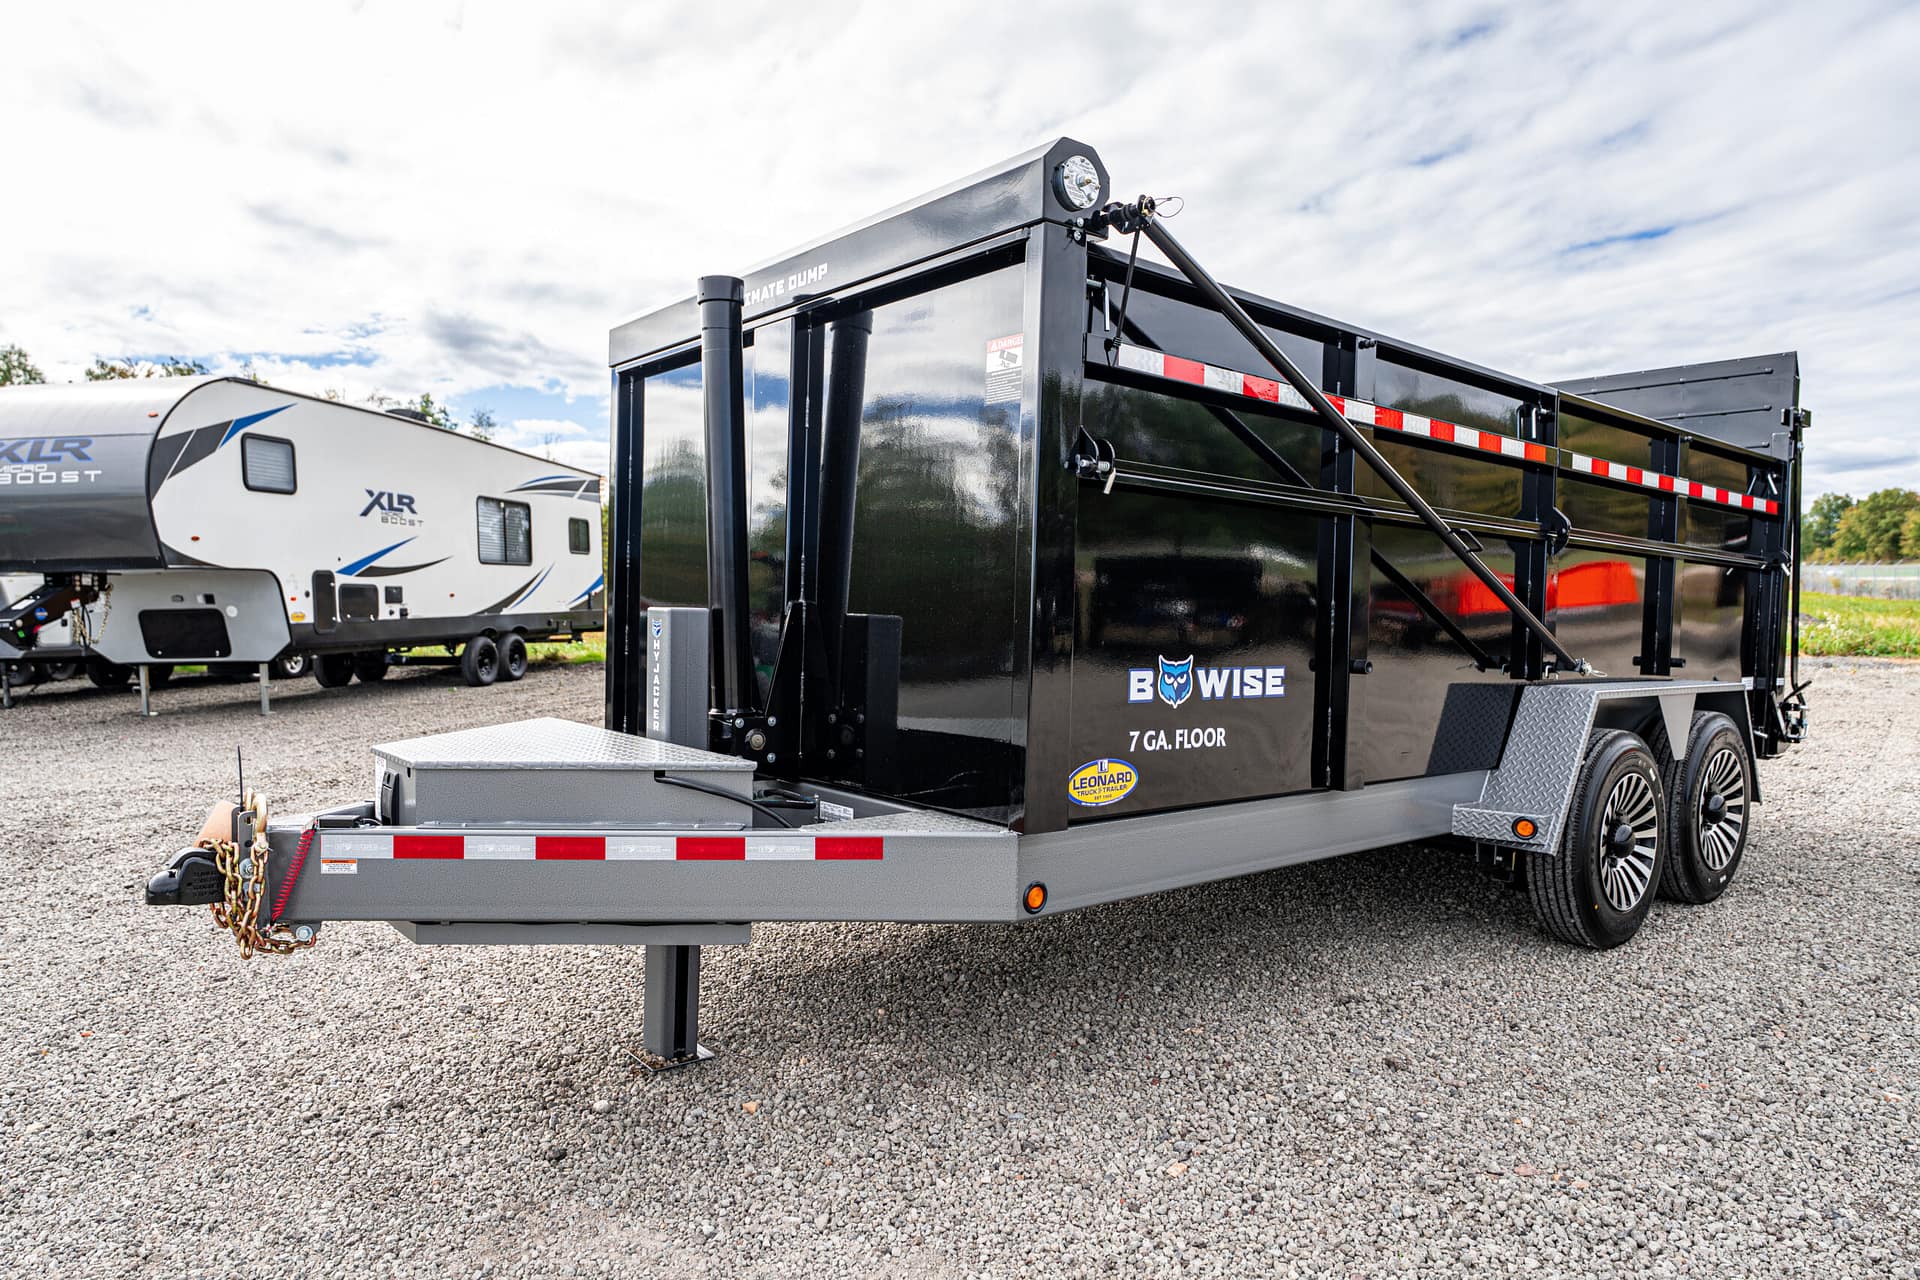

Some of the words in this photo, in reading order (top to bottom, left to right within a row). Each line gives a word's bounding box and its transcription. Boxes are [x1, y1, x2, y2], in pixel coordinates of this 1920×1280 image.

[744, 279, 785, 307] IMATE
[788, 263, 828, 291] DUMP
[0, 470, 102, 485] BOOST
[359, 488, 418, 516] XLR
[381, 515, 424, 527] BOOST
[1129, 730, 1141, 752] 7
[1143, 729, 1172, 751] GA.
[1175, 727, 1226, 749] FLOOR
[1073, 771, 1132, 790] LEONARD
[1077, 788, 1097, 797] TRUCK
[1103, 783, 1127, 793] TRAILER
